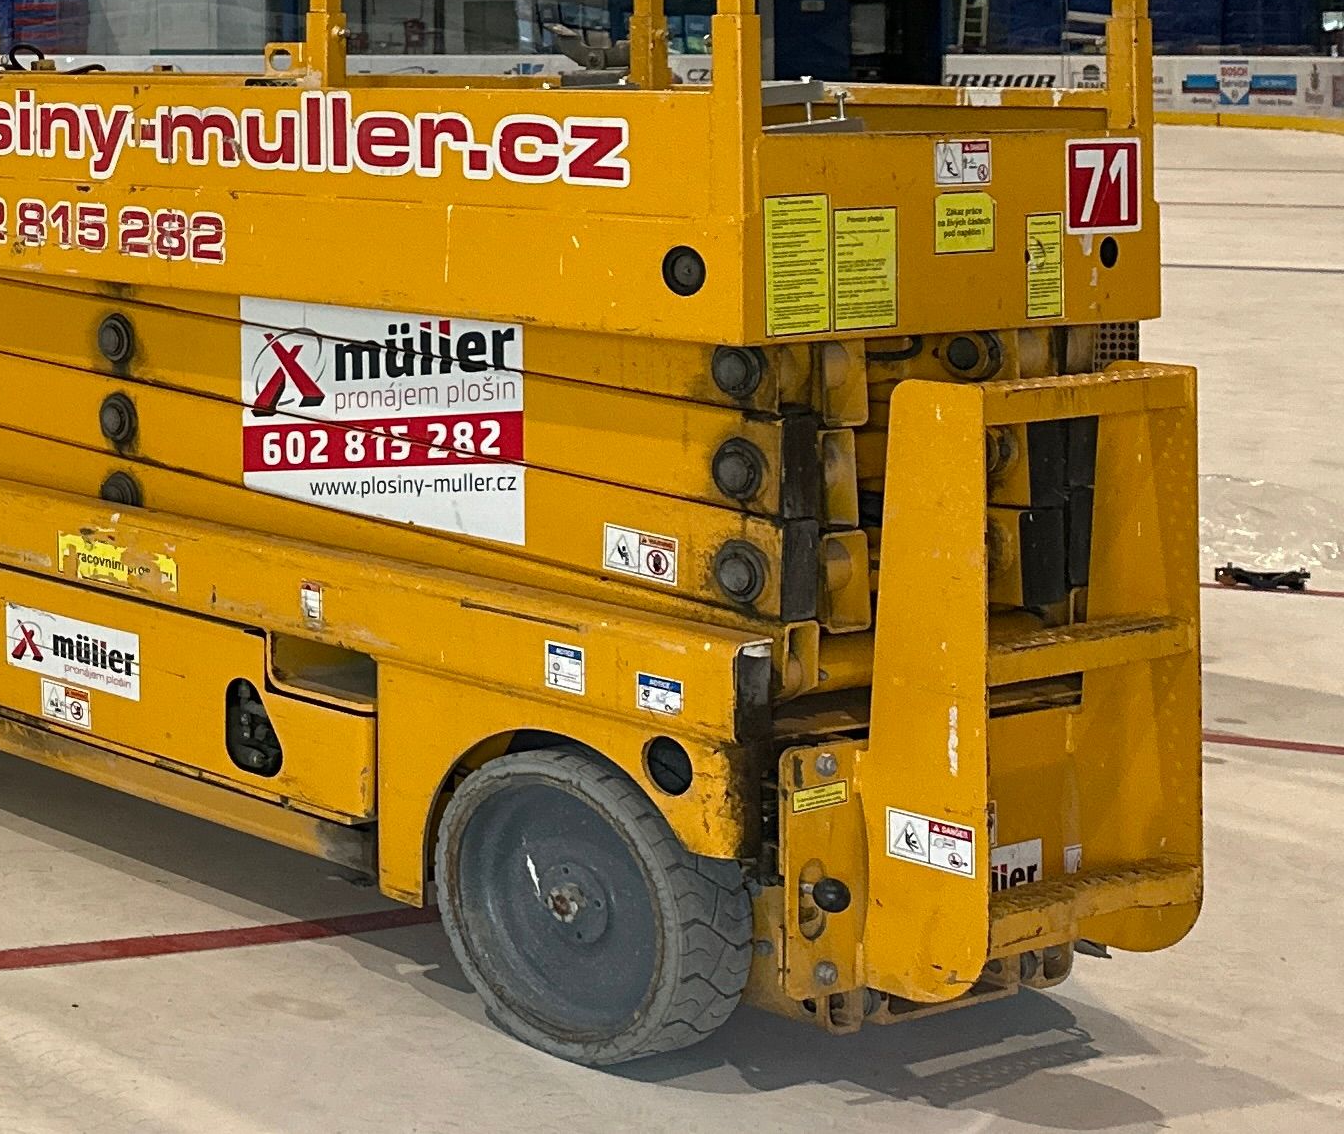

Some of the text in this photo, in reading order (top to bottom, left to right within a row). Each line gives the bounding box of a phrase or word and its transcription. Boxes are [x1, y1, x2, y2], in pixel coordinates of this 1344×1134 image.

[1074, 147, 1131, 224] 71
[16, 197, 109, 252] 815
[118, 206, 226, 265] 282
[334, 319, 516, 382] müller
[334, 371, 517, 415] pronájem plošin
[261, 419, 502, 466] 602 815 282
[310, 472, 517, 499] www.plosiny-muller.cz
[52, 633, 135, 677] müller
[64, 664, 106, 681] pronájem
[941, 823, 970, 840] DANGER
